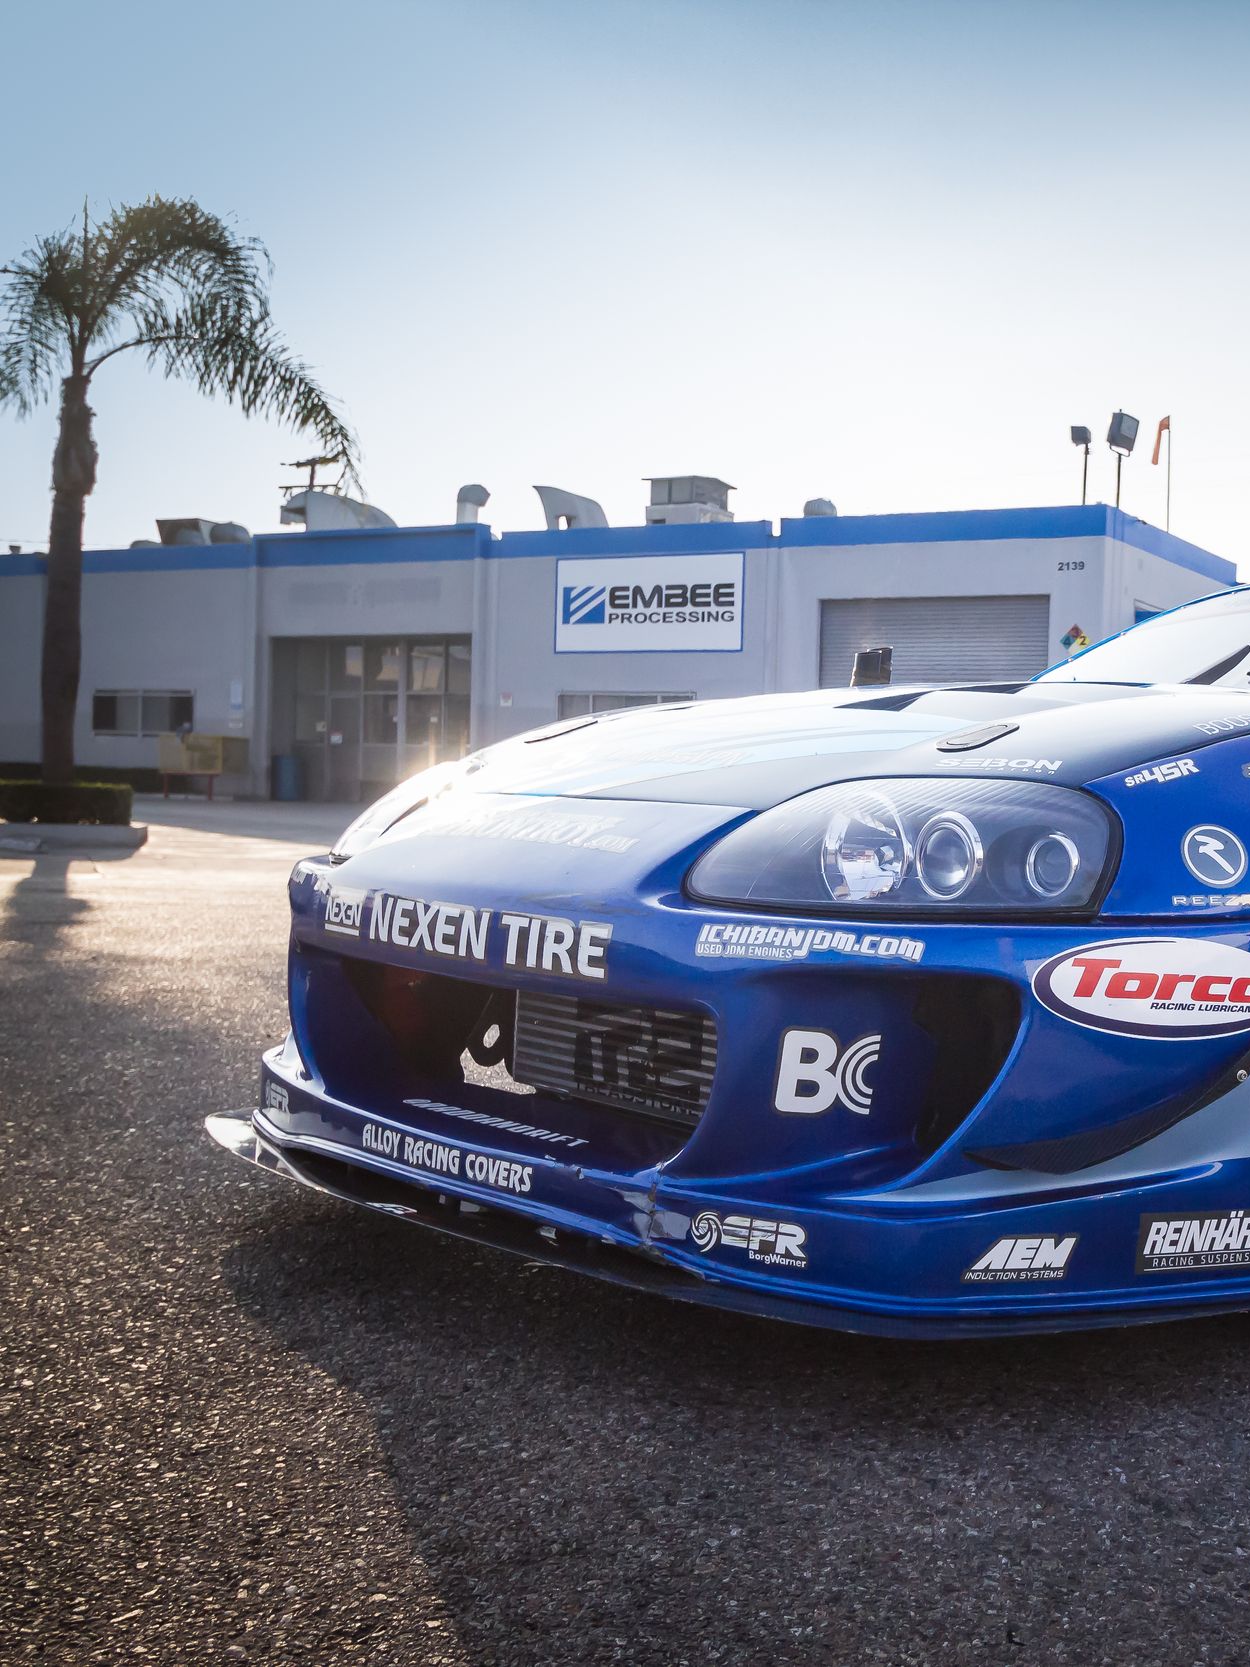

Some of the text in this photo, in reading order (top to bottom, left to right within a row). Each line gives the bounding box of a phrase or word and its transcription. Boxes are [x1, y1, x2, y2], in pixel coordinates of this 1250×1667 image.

[1057, 561, 1085, 571] 2139
[609, 583, 735, 609] EMBEE
[608, 610, 735, 625] PROCESSING
[1078, 635, 1087, 646] 2
[324, 896, 612, 979] NEXEN NEXEN TIRE
[697, 943, 793, 959] USED JDM ENGINES
[1150, 1002, 1195, 1012] RACING
[362, 1123, 533, 1193] ALLOY RACING COVERS
[721, 1215, 806, 1258] EFR
[749, 1250, 807, 1268] BorgWarner
[971, 1238, 1077, 1270] AEM
[1153, 1256, 1195, 1267] RACING
[964, 1270, 1064, 1281] INDUCTION SYSTEMS
